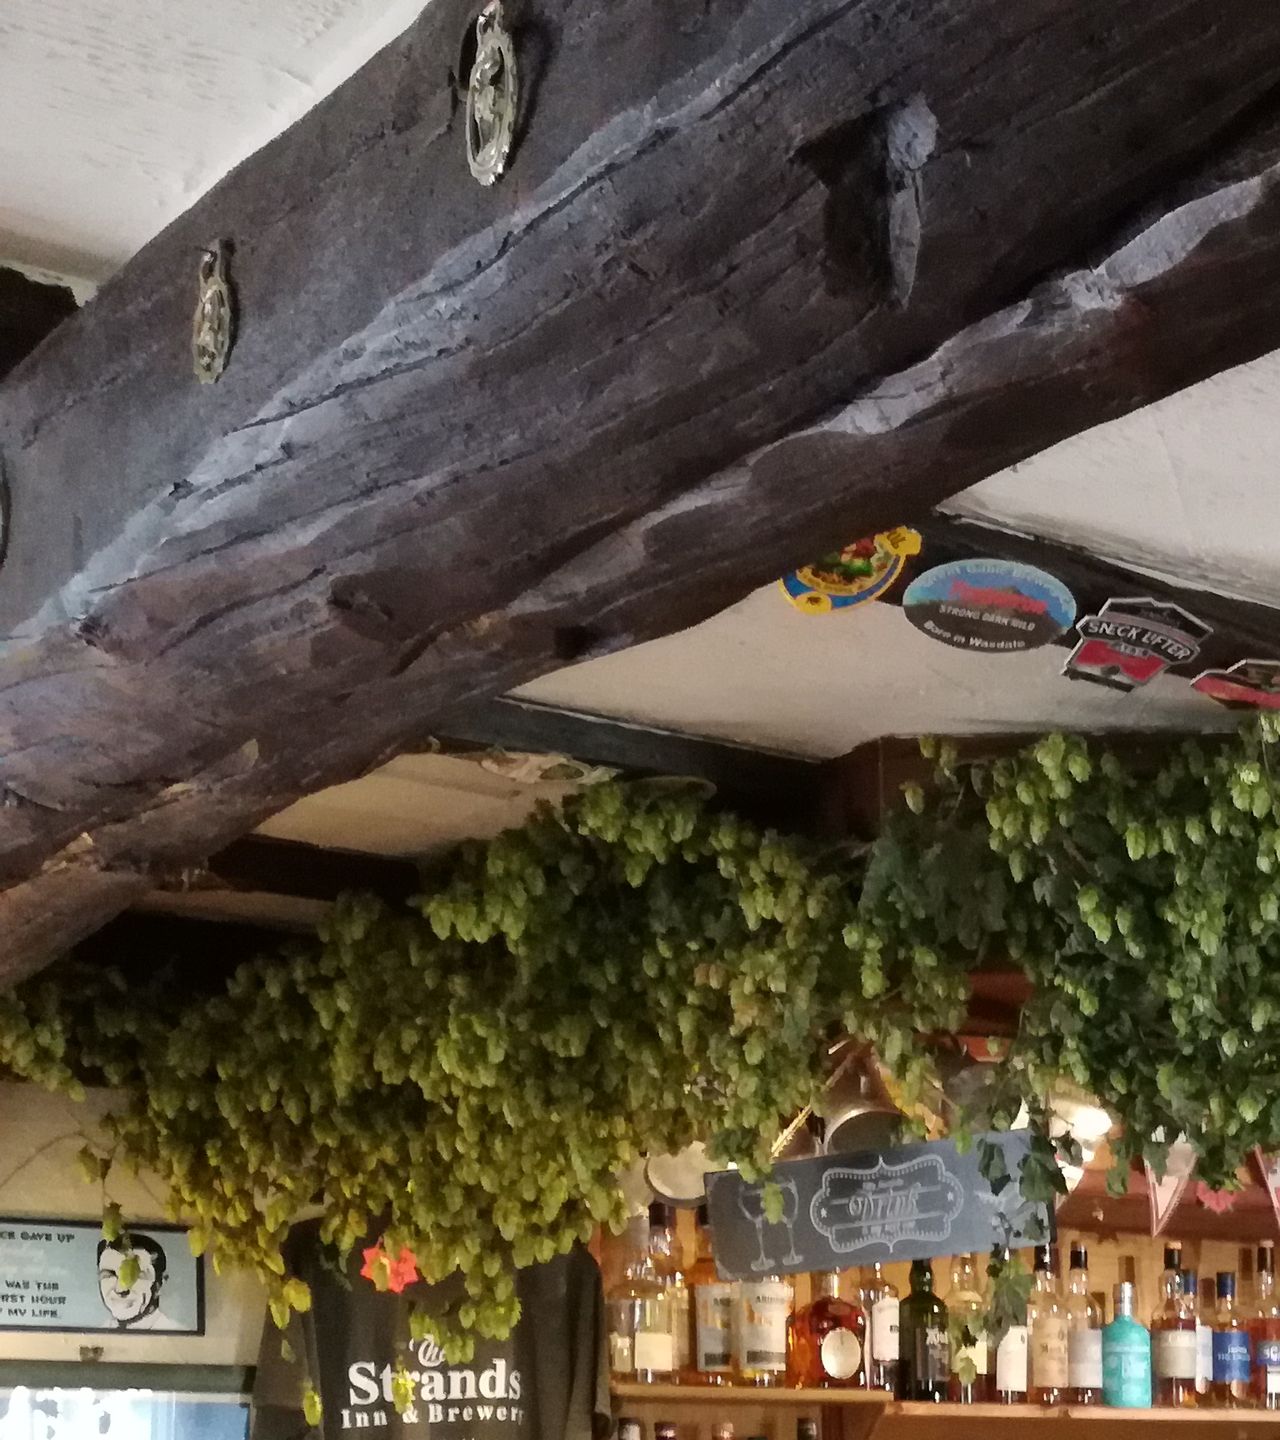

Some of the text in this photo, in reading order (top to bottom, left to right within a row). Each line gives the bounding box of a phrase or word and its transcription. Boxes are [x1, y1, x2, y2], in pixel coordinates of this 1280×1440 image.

[1087, 621, 1144, 643] SNECK
[1140, 630, 1192, 661] LIFTER
[20, 1232, 52, 1243] GAVE
[57, 1233, 75, 1244] UP
[5, 1279, 30, 1290] WAS
[1, 1294, 26, 1305] RST
[348, 1357, 522, 1406] Strands
[341, 1407, 388, 1430] Inn
[402, 1403, 419, 1425] &
